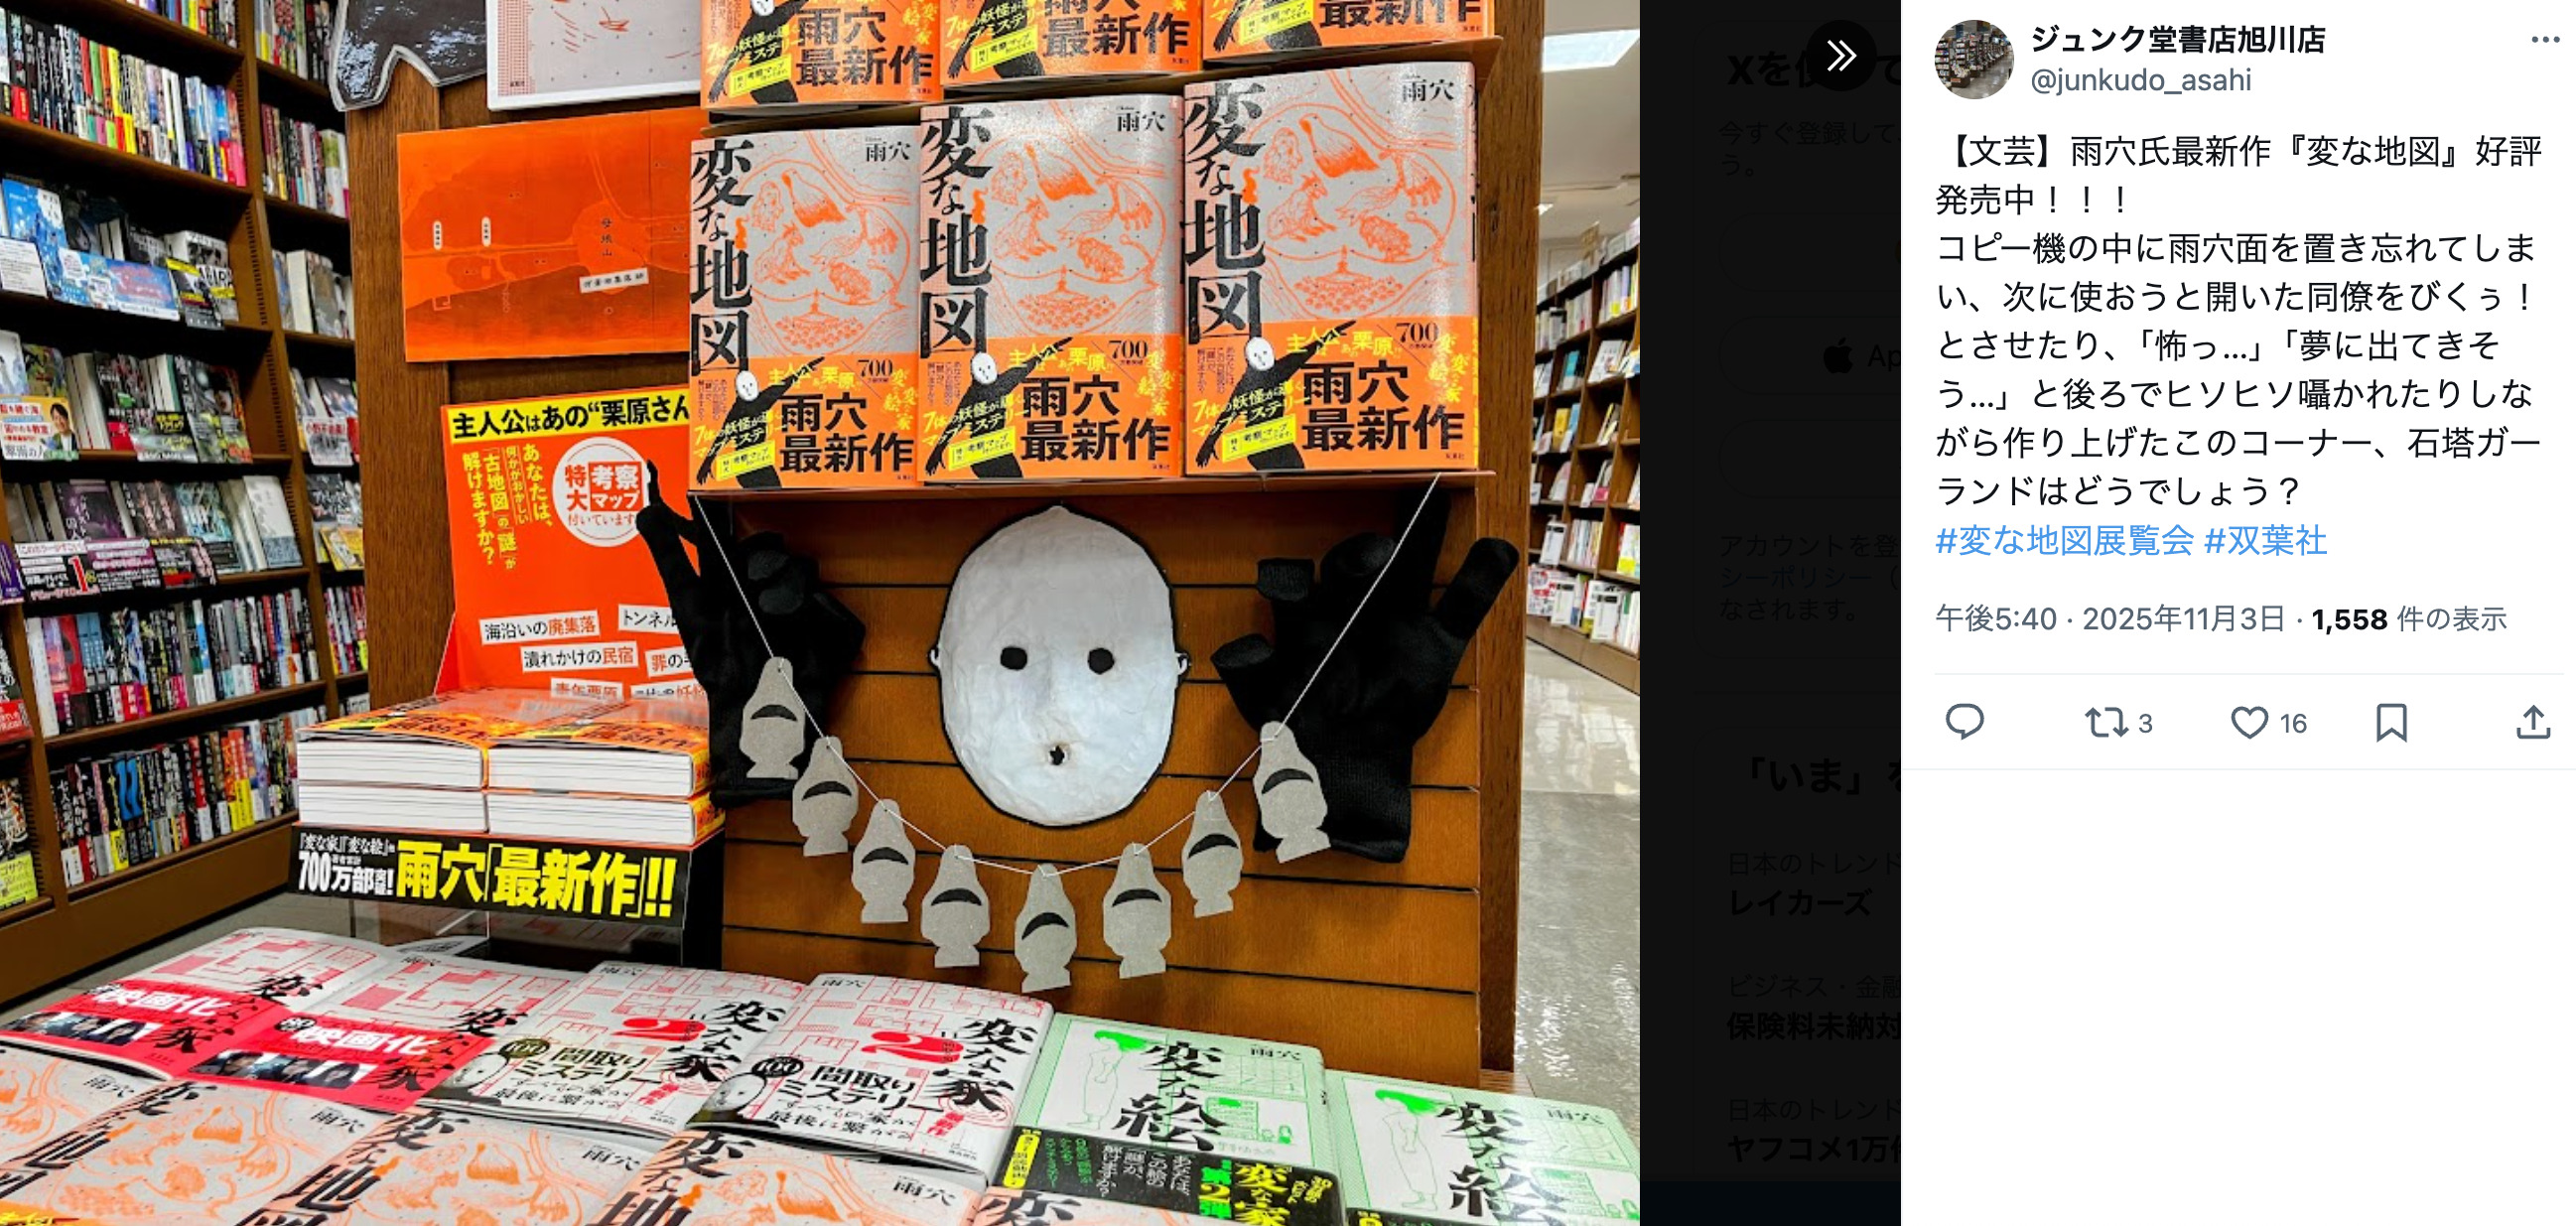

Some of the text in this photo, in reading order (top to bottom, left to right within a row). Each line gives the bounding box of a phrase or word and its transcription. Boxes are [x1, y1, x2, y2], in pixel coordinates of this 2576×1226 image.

[795, 6, 886, 46] 雨穴
[1042, 12, 1191, 58] 最新作
[796, 46, 934, 86] 最新作
[1401, 77, 1455, 102] 雨穴
[1116, 110, 1166, 133] 雨穴
[865, 141, 911, 163] 雨穴
[1182, 81, 1267, 345] 変な地図
[919, 105, 995, 359] 変な地図
[690, 138, 755, 377] 変な地図
[1108, 340, 1149, 360] 700
[1395, 322, 1439, 343] 700
[857, 358, 893, 378] 700
[1299, 358, 1411, 407] 雨穴
[776, 391, 868, 433] 雨穴
[1020, 373, 1121, 418] 雨穴
[1019, 417, 1172, 463] 最新作
[1300, 405, 1465, 452] 最新作
[779, 433, 914, 473] 最新作
[521, 443, 554, 528] あなたは、
[564, 464, 589, 512] 特大
[591, 465, 639, 490] 考察
[591, 489, 641, 509] マップ
[484, 613, 597, 642] 海沿いの廃集落
[523, 644, 634, 670] 潰れかけの民宿
[91, 988, 233, 1018] 映画化
[289, 1024, 441, 1055] 映画化
[608, 1017, 707, 1042] 2
[645, 1000, 787, 1083] 変な家
[551, 1046, 647, 1069] 間取り
[861, 1030, 965, 1065] 2
[919, 1017, 1039, 1113] 変な家
[515, 1058, 662, 1084] ミステリー
[810, 1064, 916, 1094] 間取り
[776, 1078, 945, 1113] ミステリー
[1112, 1040, 1230, 1152] 変な絵
[311, 1106, 365, 1134] 雨穴
[581, 1145, 641, 1171] 雨穴
[1435, 1101, 1570, 1226] 変な絵
[891, 1176, 958, 1207] 雨穴
